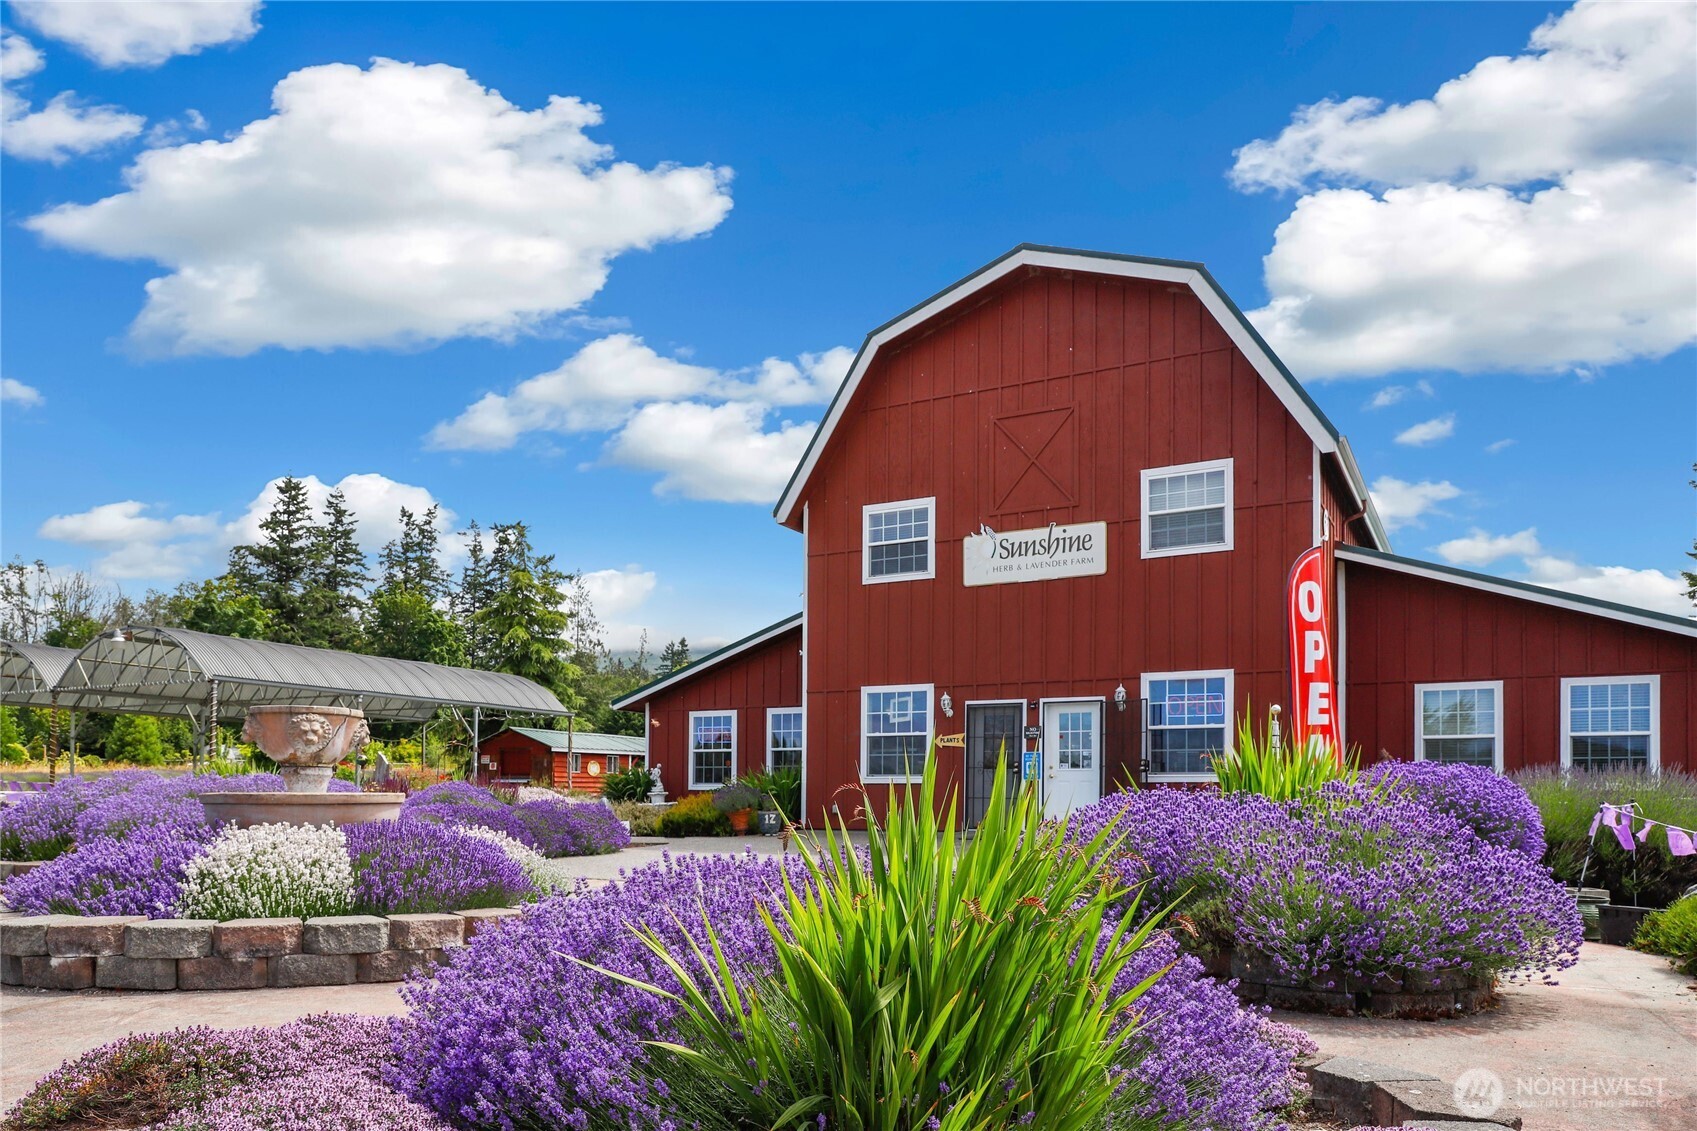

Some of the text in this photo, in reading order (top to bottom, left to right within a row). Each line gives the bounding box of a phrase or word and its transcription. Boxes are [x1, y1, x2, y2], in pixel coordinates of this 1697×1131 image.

[999, 524, 1093, 559] Sunshine
[992, 565, 1013, 573] HERB
[1025, 559, 1068, 570] LAVENDER
[1070, 557, 1094, 565] FARM
[1168, 695, 1222, 715] OPEN
